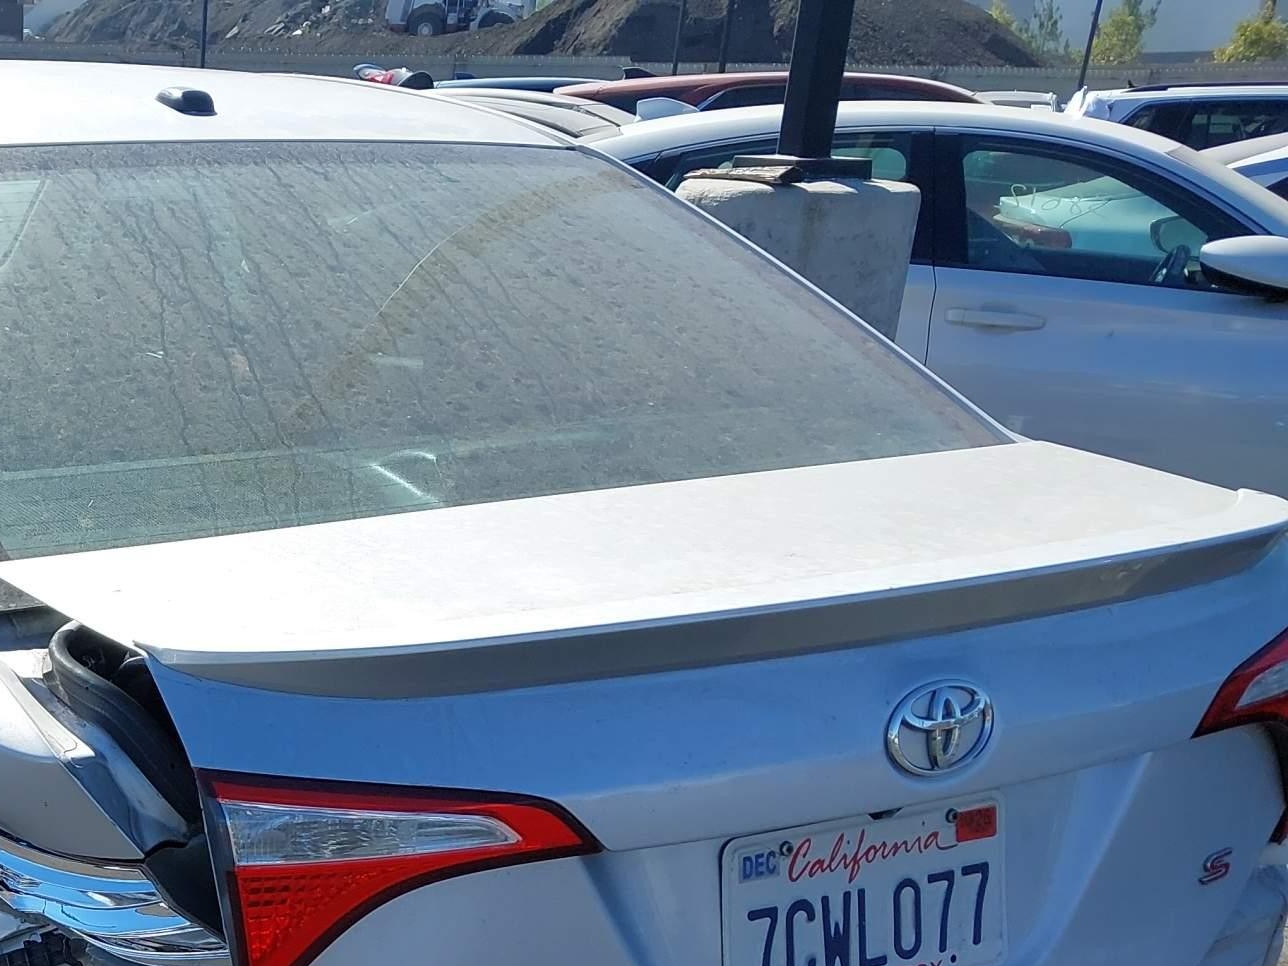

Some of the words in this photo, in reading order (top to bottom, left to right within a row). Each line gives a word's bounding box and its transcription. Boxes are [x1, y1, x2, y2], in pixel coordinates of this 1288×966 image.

[742, 850, 777, 880] DEC
[788, 829, 958, 884] California
[1198, 847, 1232, 885] S
